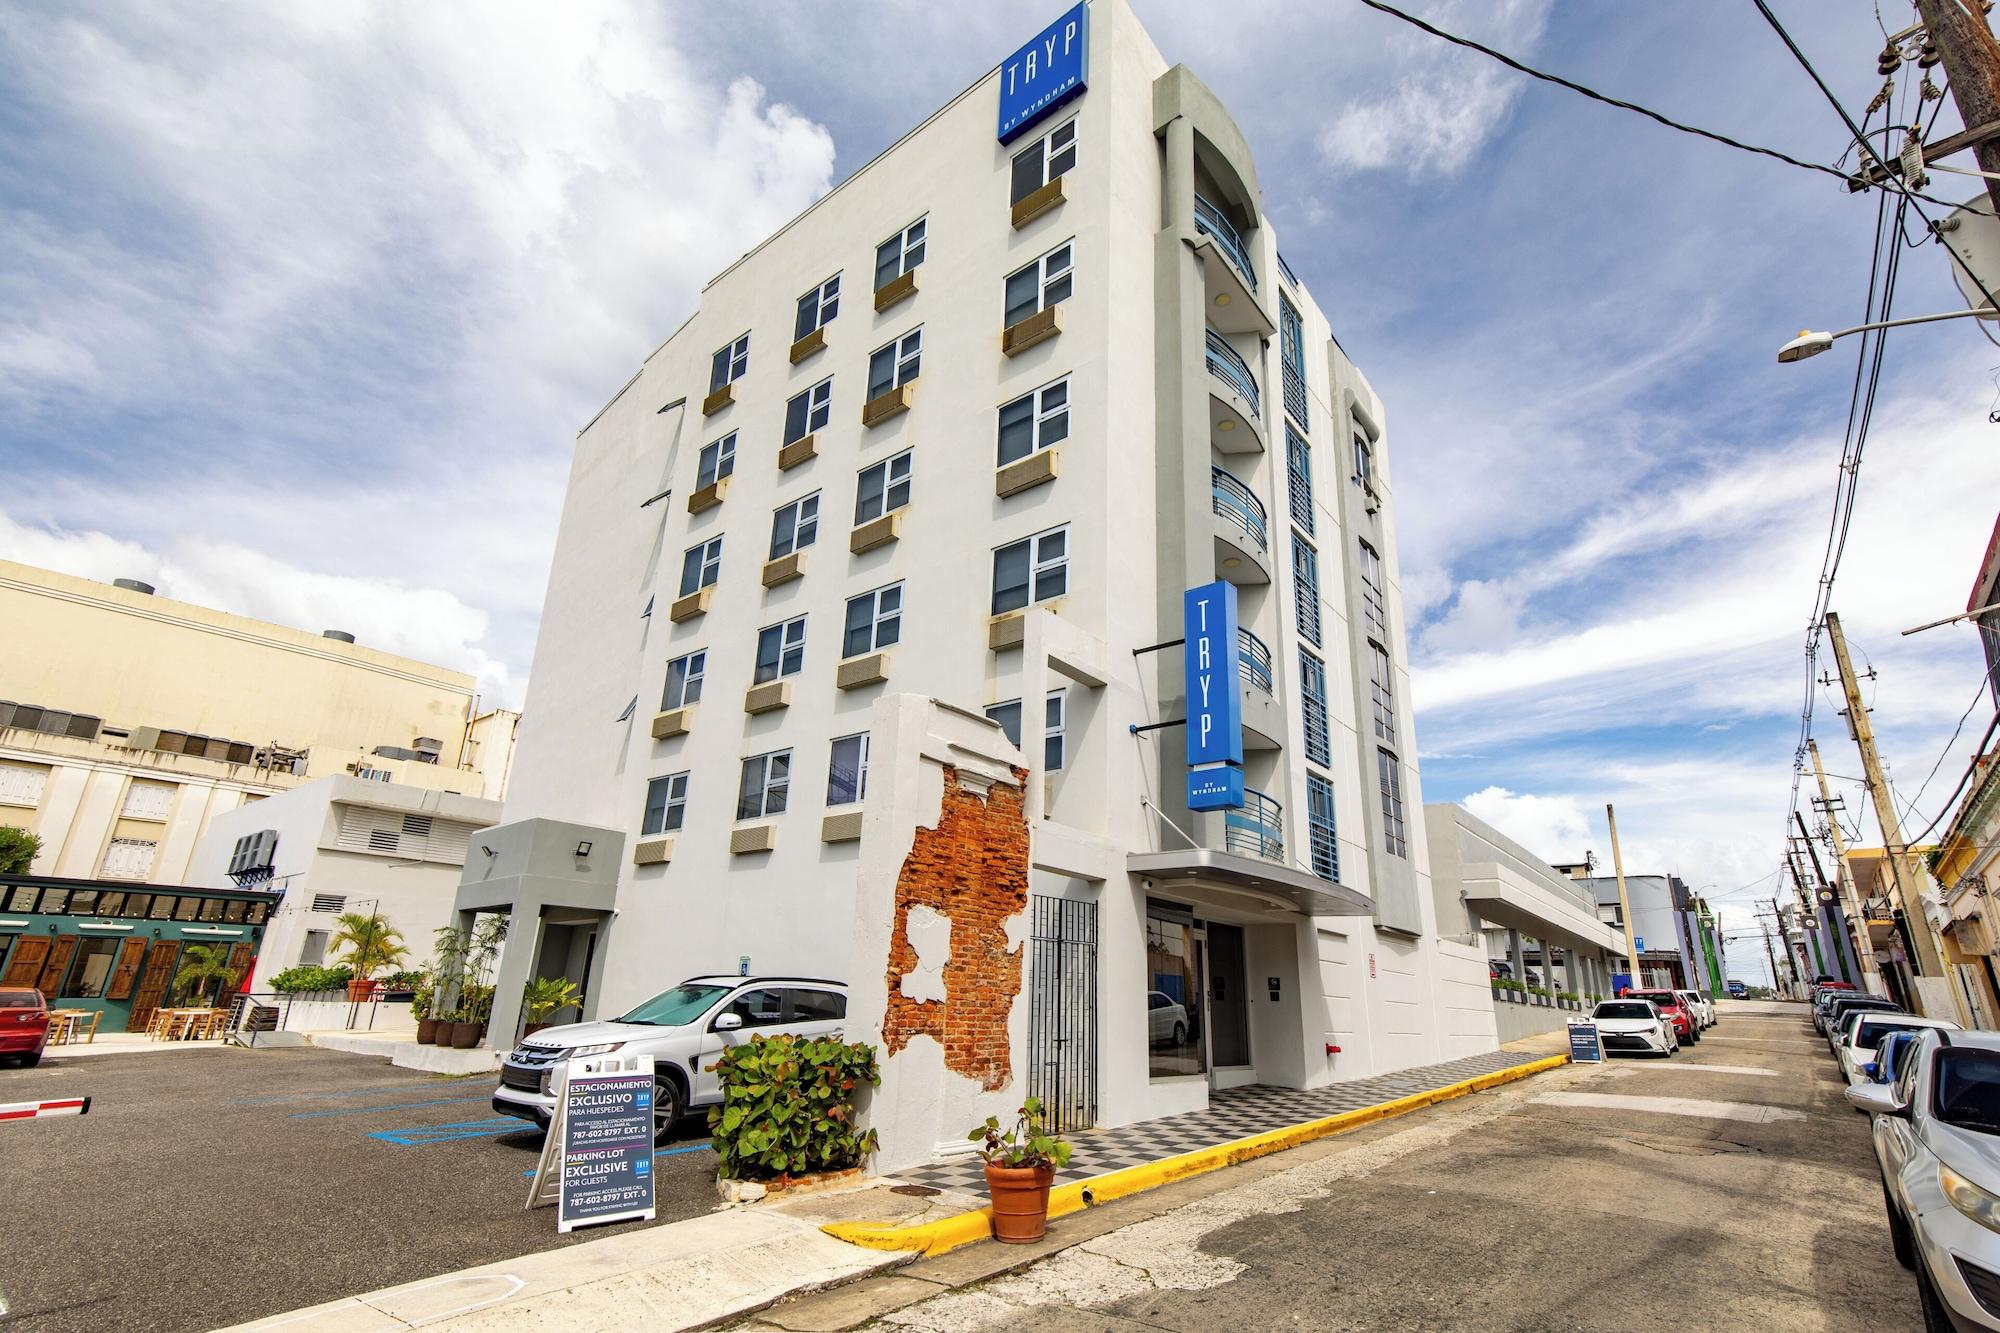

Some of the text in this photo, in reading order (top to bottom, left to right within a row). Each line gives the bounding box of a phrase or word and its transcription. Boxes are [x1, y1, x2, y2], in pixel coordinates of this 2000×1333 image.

[1008, 21, 1076, 95] TRYP
[1004, 76, 1075, 130] BY WYNDHAM
[1198, 600, 1212, 748] TRYP
[570, 1080, 652, 1092] ESTACIONAMIENTO
[570, 1094, 632, 1106] EXCLUSIVO
[569, 1108, 586, 1116] PARA
[573, 1128, 621, 1139] 787-602-8797
[567, 1149, 624, 1162] PARKING LOT
[566, 1162, 628, 1177] EXCLUSIVE
[565, 1176, 608, 1187] FOR GUESTS
[570, 1193, 621, 1206] 787-602-8797
[624, 1191, 640, 1199] EXT.
